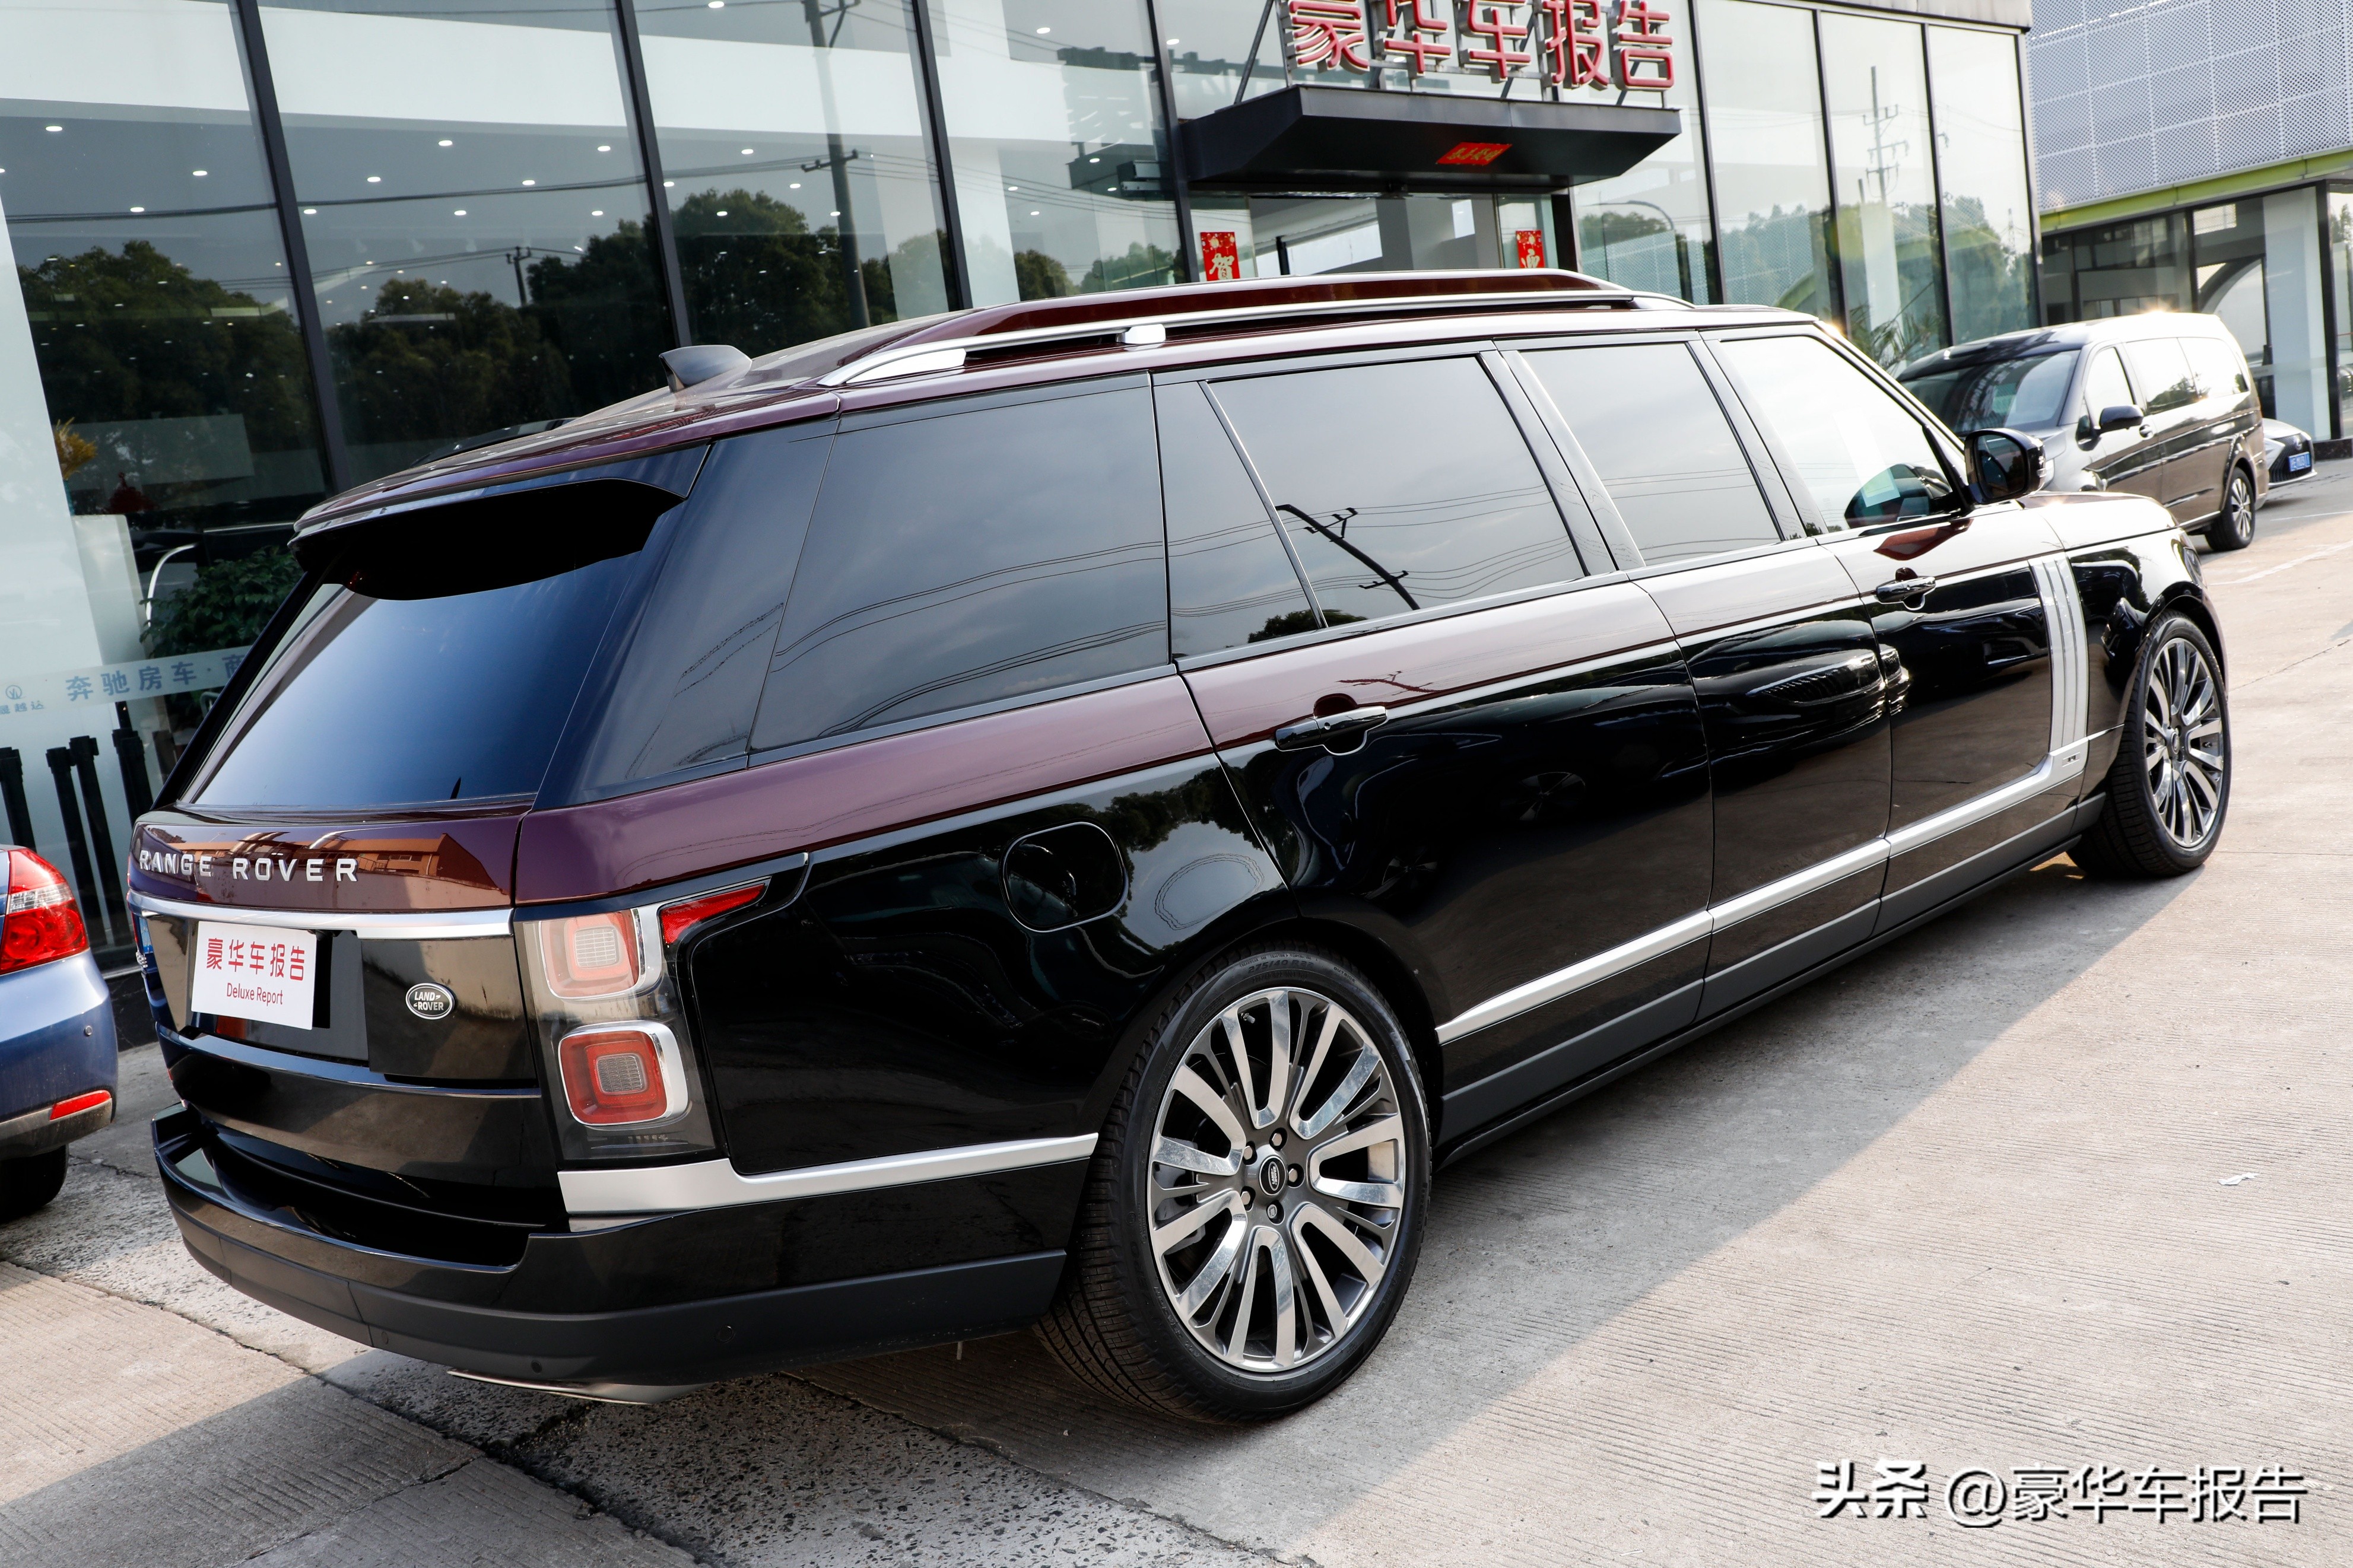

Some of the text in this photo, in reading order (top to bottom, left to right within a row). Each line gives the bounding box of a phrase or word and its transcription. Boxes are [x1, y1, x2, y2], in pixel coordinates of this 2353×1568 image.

[1285, 0, 1675, 90] 豪华车报告
[139, 850, 358, 882] RANGE ROVER
[207, 938, 305, 981] 豪华车报告
[1248, 959, 1288, 973] 275/40
[1333, 966, 1356, 982] OUTSIDE
[226, 982, 283, 1007] Deluxe Report
[414, 991, 436, 1001] LAND
[417, 1001, 444, 1011] ROVER
